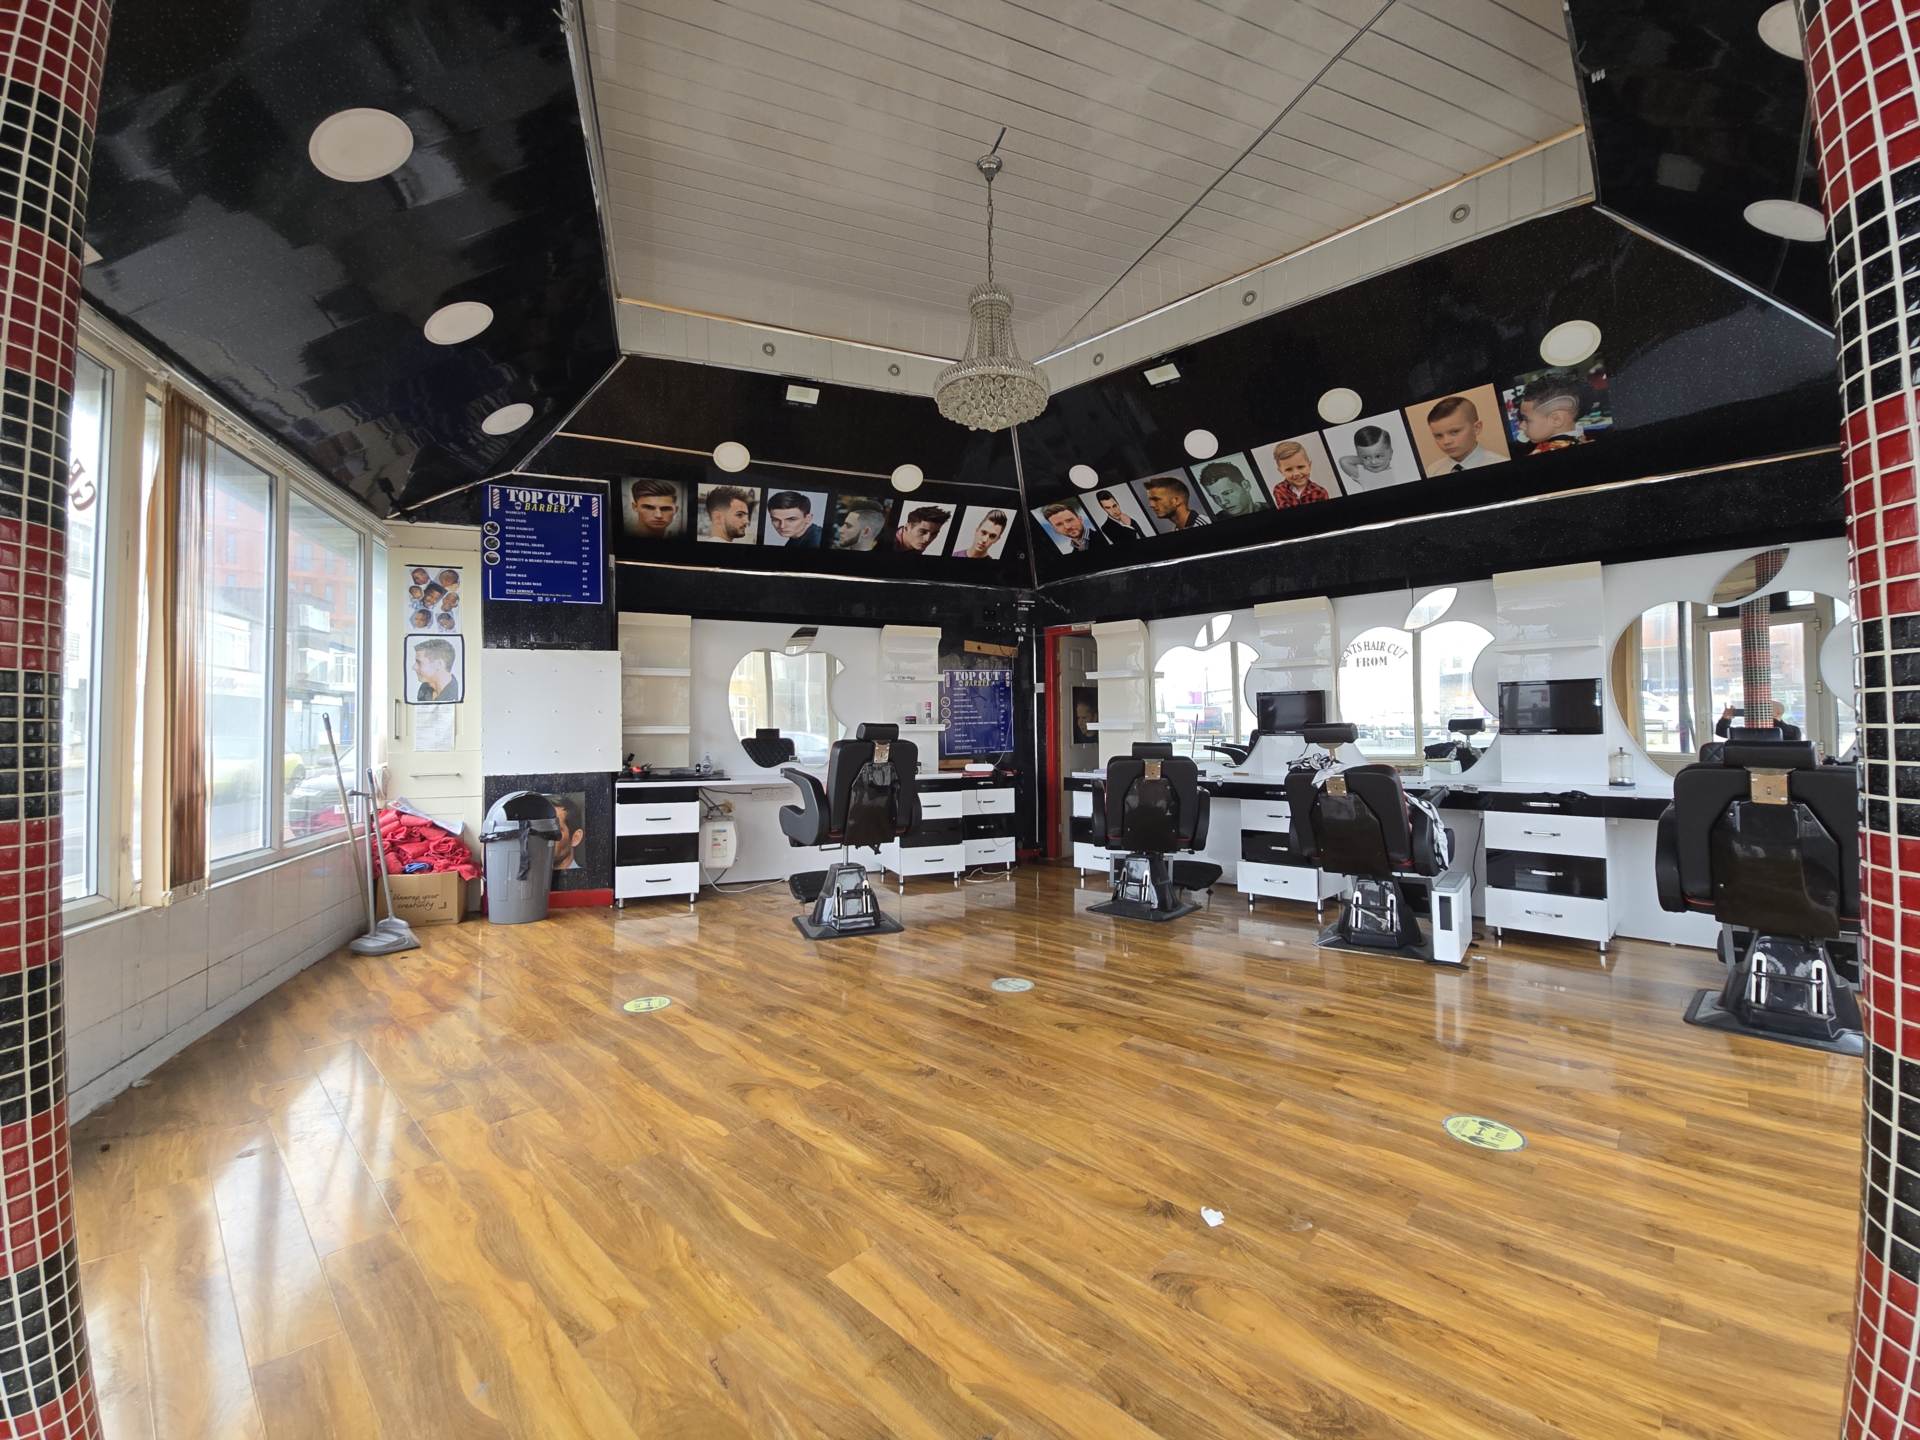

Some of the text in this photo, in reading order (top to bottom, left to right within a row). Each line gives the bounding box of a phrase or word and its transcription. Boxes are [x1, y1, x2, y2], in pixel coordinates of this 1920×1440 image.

[506, 489, 582, 507] TOP CUT
[524, 503, 566, 513] BARBER
[1363, 640, 1386, 651] HAIR
[1387, 643, 1409, 659] CUT
[1356, 655, 1388, 667] FROM
[954, 671, 1000, 680] TOP CUT
